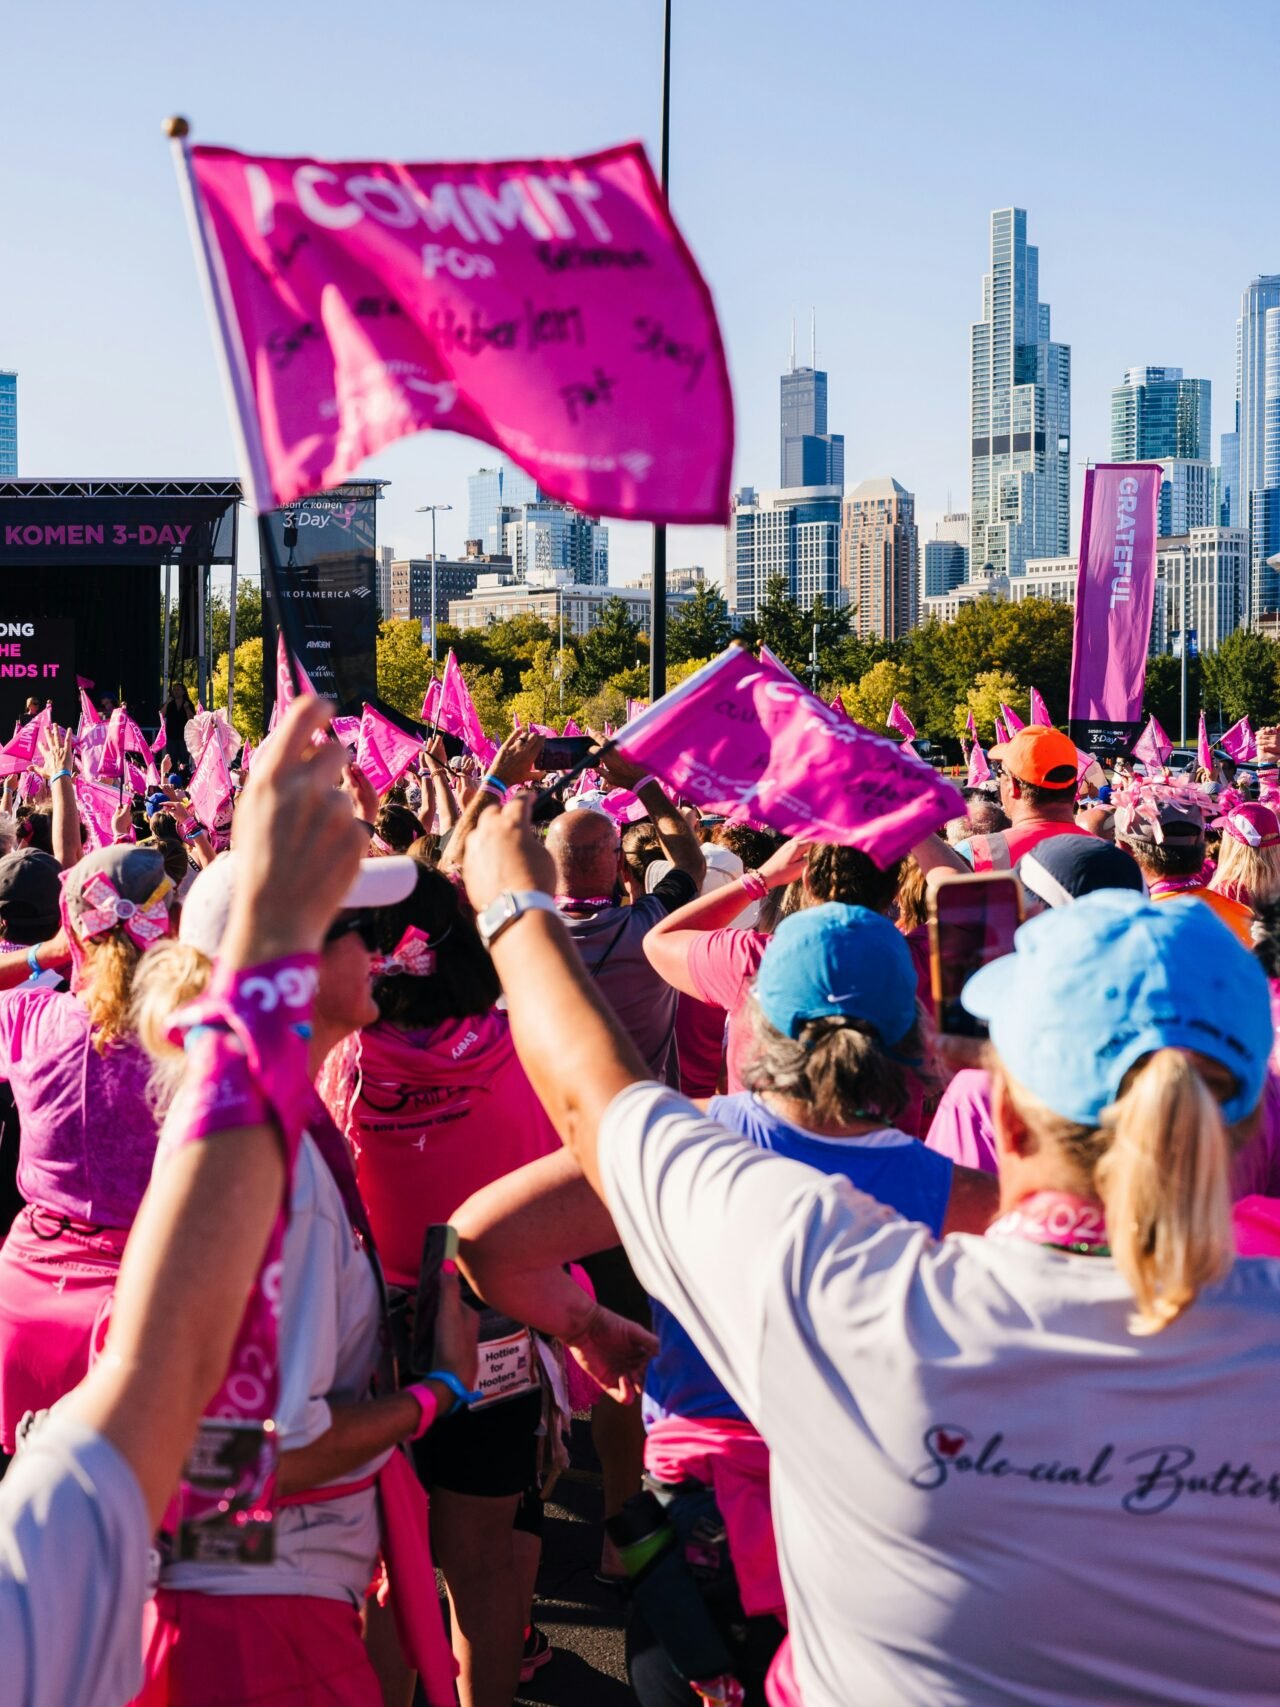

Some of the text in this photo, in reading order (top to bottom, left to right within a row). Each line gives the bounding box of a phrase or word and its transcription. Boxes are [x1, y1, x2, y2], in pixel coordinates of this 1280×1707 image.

[291, 164, 613, 244] COMMIT
[422, 243, 495, 282] FOR
[5, 525, 104, 544] KOMEN
[112, 525, 192, 545] 3-DAY
[1109, 476, 1139, 609] GRATEFUL
[43, 664, 60, 677] IT
[451, 1031, 478, 1060] Every
[485, 1345, 520, 1362] Hotties
[479, 1371, 516, 1389] Hooters
[490, 1363, 505, 1373] for
[911, 1424, 1115, 1490] Sole-cial
